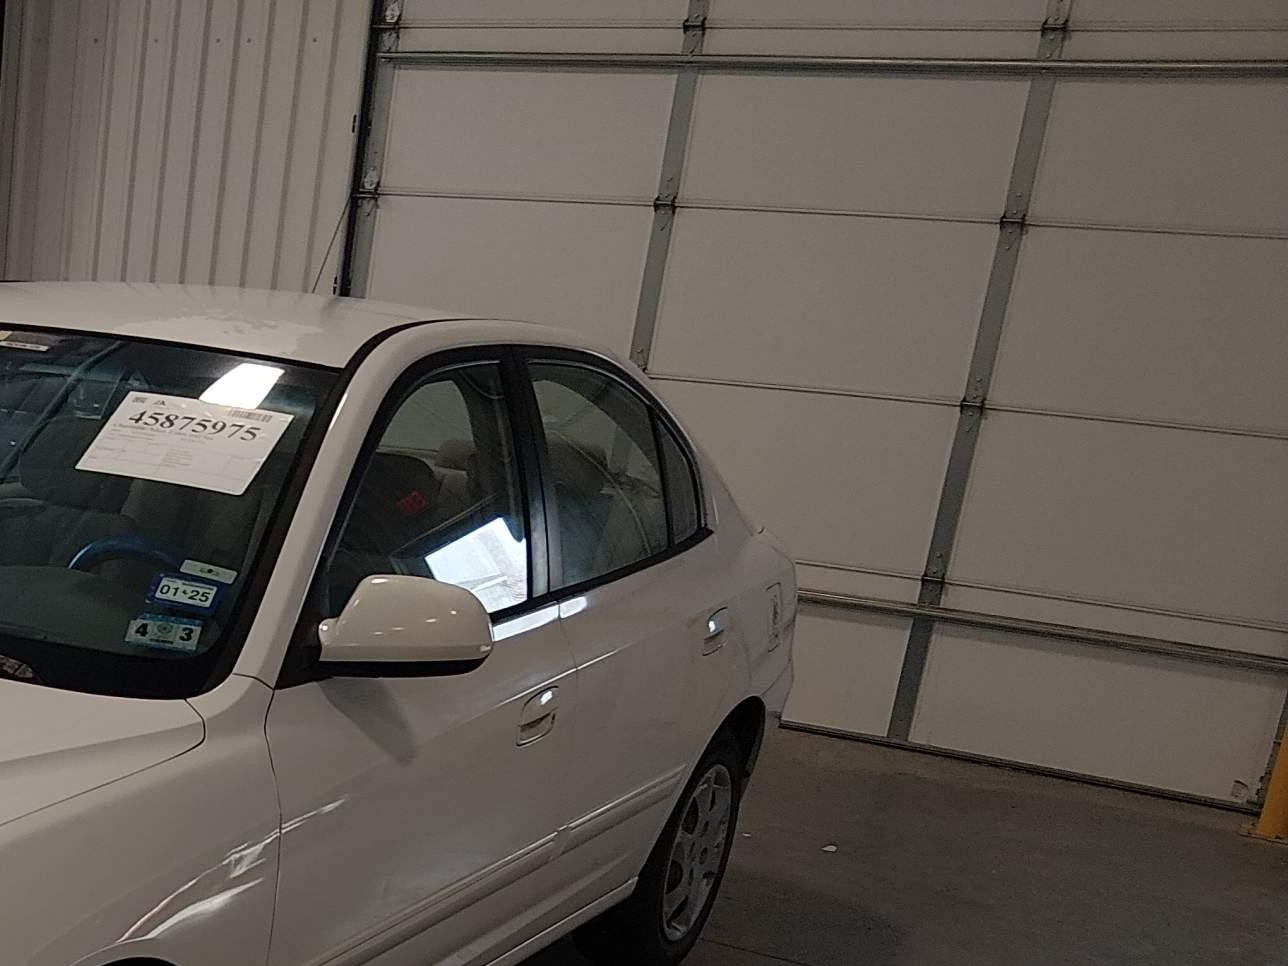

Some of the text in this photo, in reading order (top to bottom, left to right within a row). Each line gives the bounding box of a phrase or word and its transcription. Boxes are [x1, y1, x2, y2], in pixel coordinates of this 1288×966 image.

[128, 410, 261, 441] 45875975
[159, 584, 179, 597] 01
[187, 589, 211, 603] 25
[135, 623, 149, 637] 4
[179, 627, 194, 642] 3
